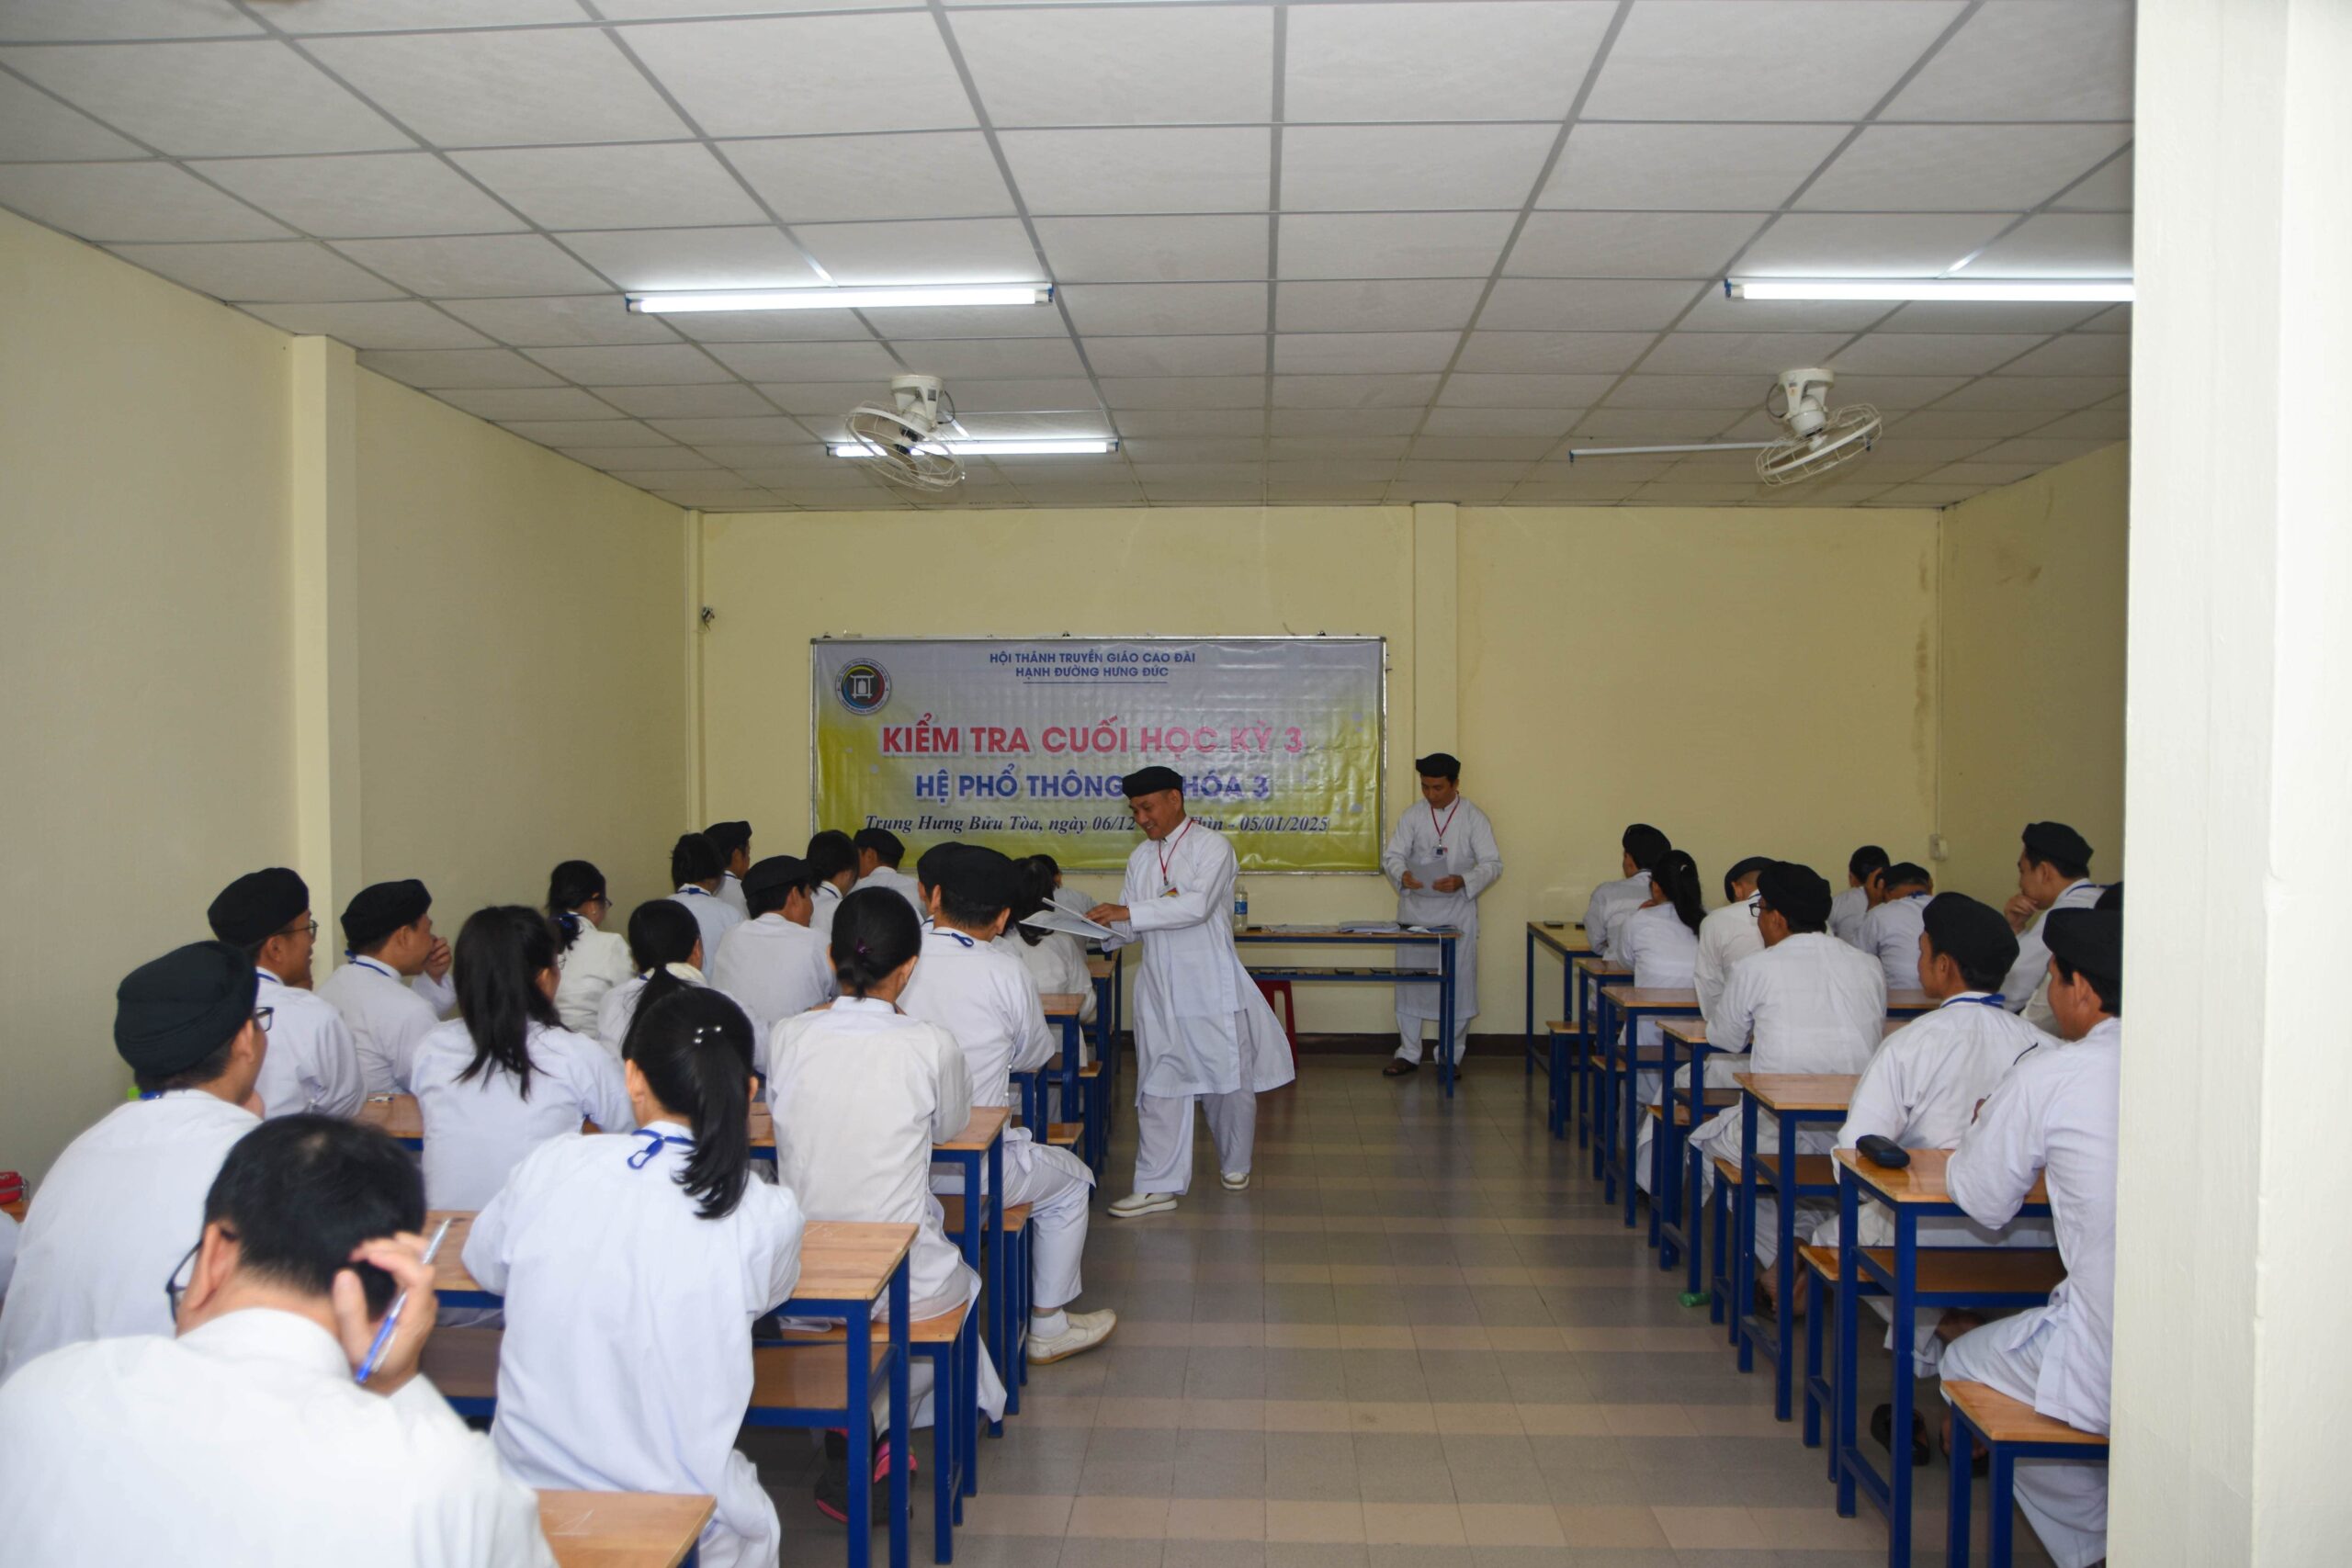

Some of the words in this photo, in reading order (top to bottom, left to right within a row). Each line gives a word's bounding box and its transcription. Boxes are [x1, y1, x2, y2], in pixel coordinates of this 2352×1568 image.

[989, 650, 1012, 666] HỘI
[1015, 650, 1056, 663] THÁNH
[1106, 650, 1139, 663] GIÁO
[1142, 652, 1170, 663] CAO
[1174, 650, 1195, 663] ĐÀI
[1015, 667, 1050, 680] HẠNH
[1054, 664, 1100, 677] ĐƯỜNG
[1102, 666, 1138, 677] HƯNG
[1142, 664, 1169, 677] ĐỨC
[883, 712, 959, 753] KIỂM
[969, 727, 1030, 753] TRA
[1041, 715, 1127, 753] CUỐI
[1140, 726, 1218, 761] HỌC
[1230, 719, 1272, 753] KỲ
[1283, 726, 1305, 753] 3
[916, 769, 949, 804] HỆ
[958, 762, 1018, 797] PHỔ
[1026, 769, 1124, 797] THÔNG
[1182, 769, 1243, 797] HÓA
[1253, 775, 1269, 797] 3
[865, 815, 913, 833] Trung
[918, 815, 964, 833] Hưng
[1010, 816, 1043, 831] Tòa,
[1048, 816, 1088, 834] ngày
[1092, 816, 1136, 830] 06/12
[1240, 816, 1329, 831] 05/01/2025
